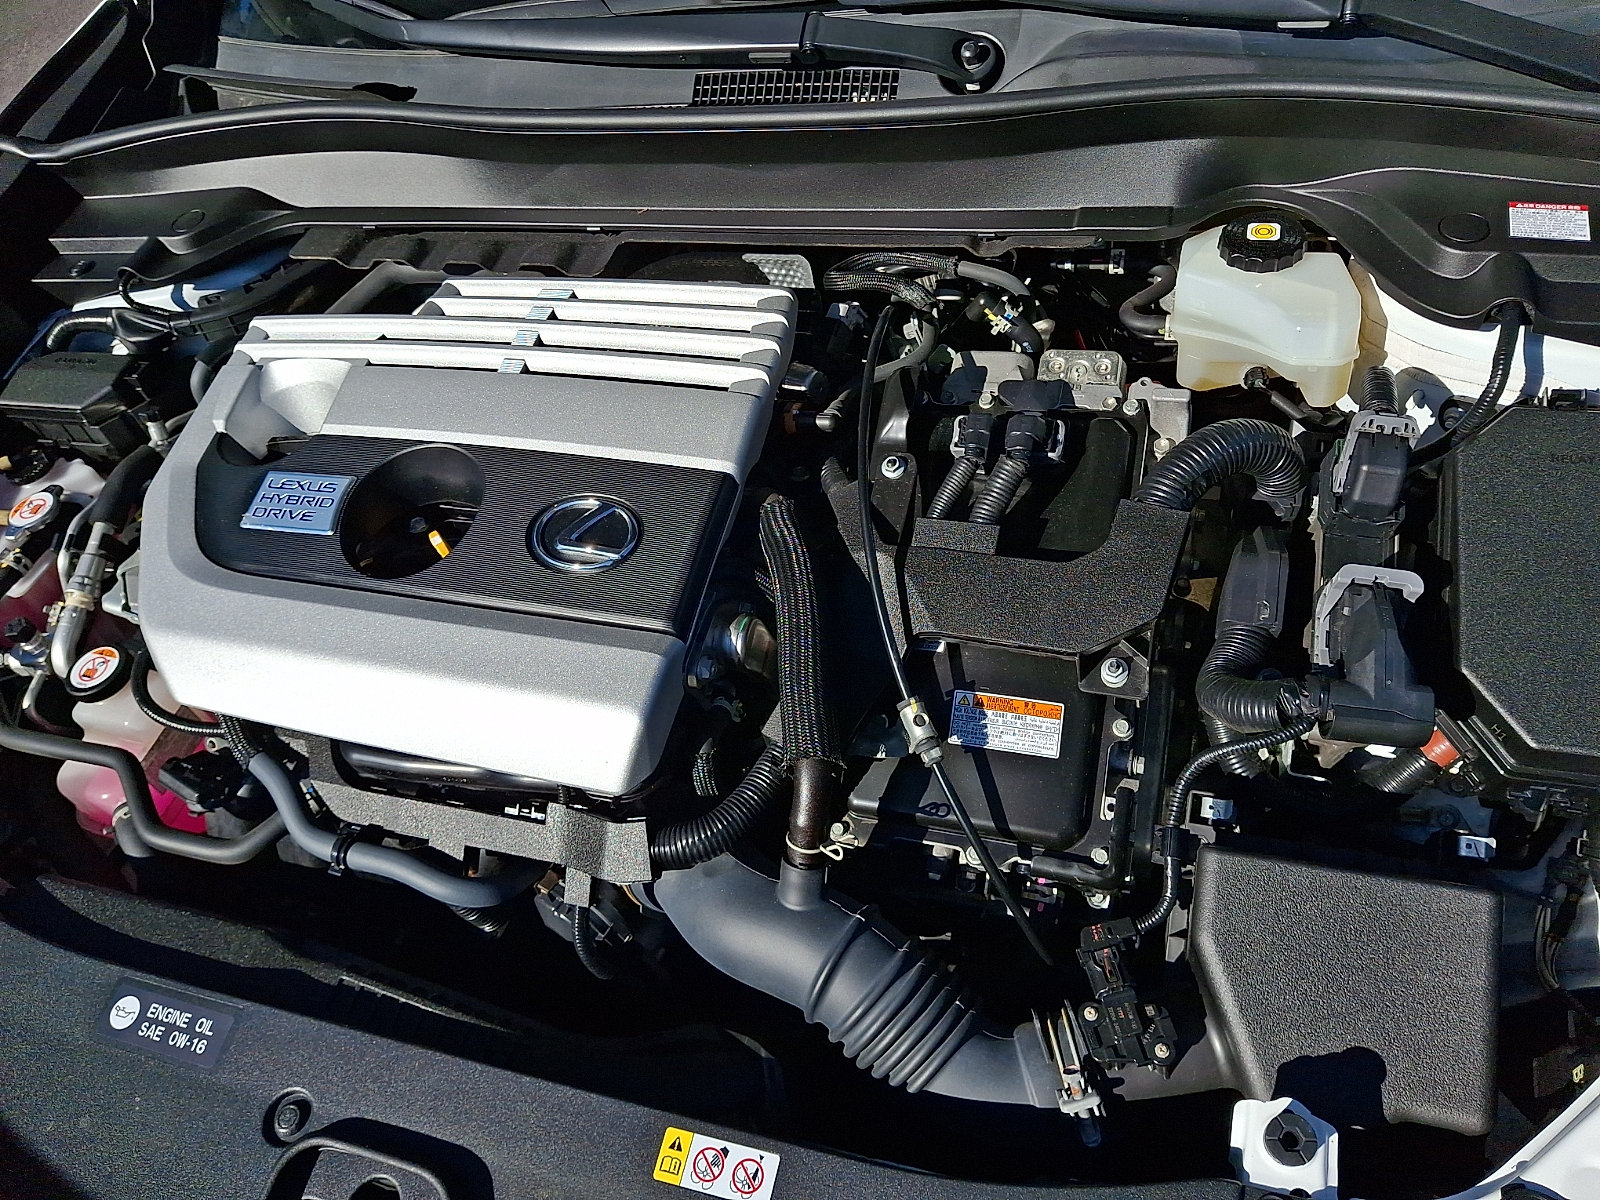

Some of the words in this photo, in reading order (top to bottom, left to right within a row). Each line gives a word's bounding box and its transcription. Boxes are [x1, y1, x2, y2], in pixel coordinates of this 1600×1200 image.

[267, 478, 339, 494] LEXUS
[259, 492, 335, 509] HYBRID
[251, 506, 317, 522] DRIVE
[986, 696, 1014, 706] WARNING
[146, 1002, 193, 1028] ENGINE
[194, 1017, 214, 1036] OIL
[137, 1021, 166, 1042] SAE
